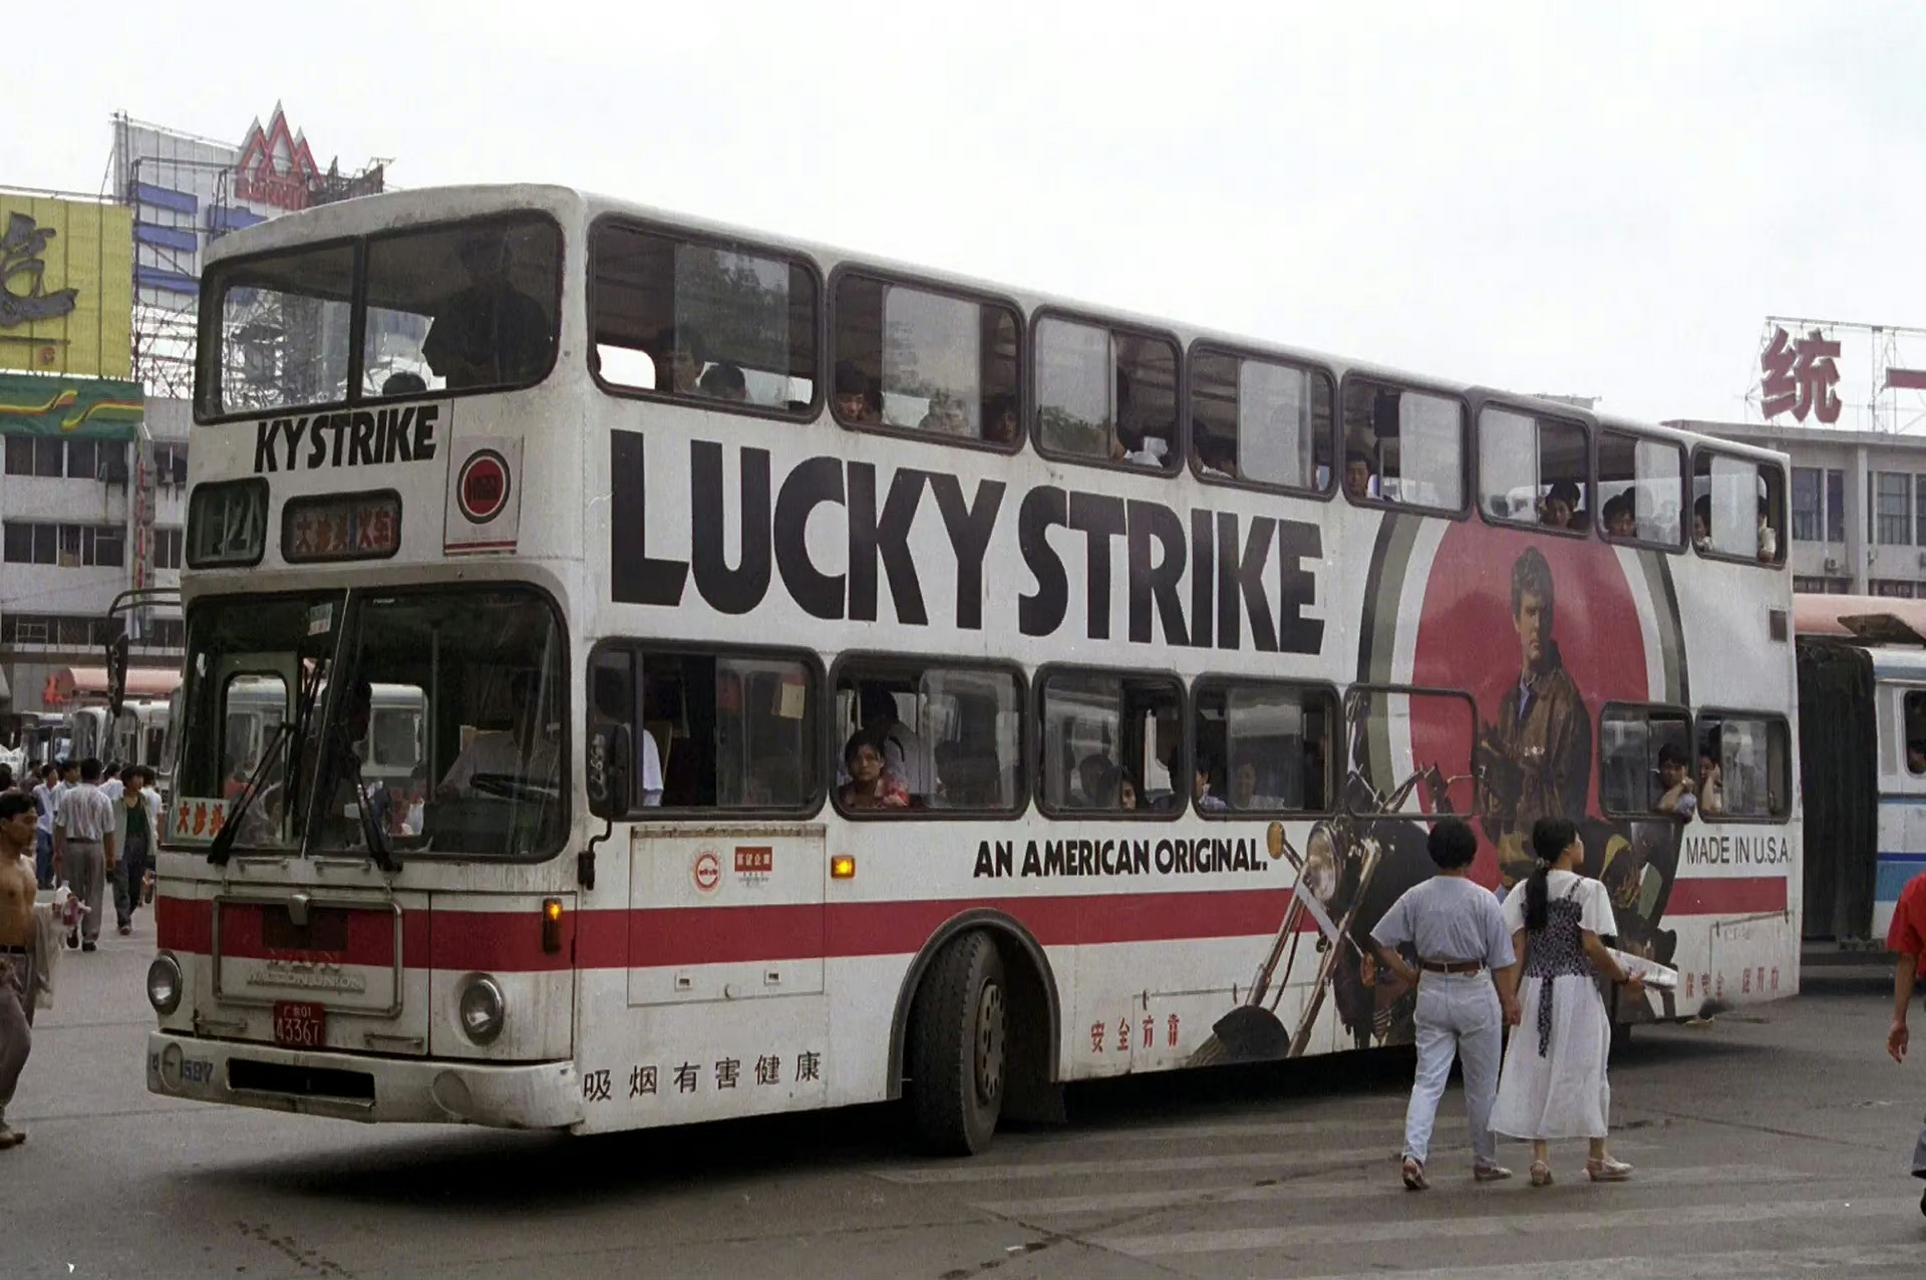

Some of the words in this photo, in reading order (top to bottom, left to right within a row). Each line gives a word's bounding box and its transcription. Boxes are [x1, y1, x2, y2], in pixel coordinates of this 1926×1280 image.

[610, 428, 1007, 630] LUCKY
[1018, 484, 1326, 655] STRIKE
[973, 840, 1013, 878] AN
[1021, 839, 1150, 877] AMERICAN
[1154, 838, 1268, 875] ORIGINAL.
[1686, 836, 1730, 865] MADE
[1735, 836, 1750, 863] IN
[582, 1050, 822, 1102] 吸烟有害健康
